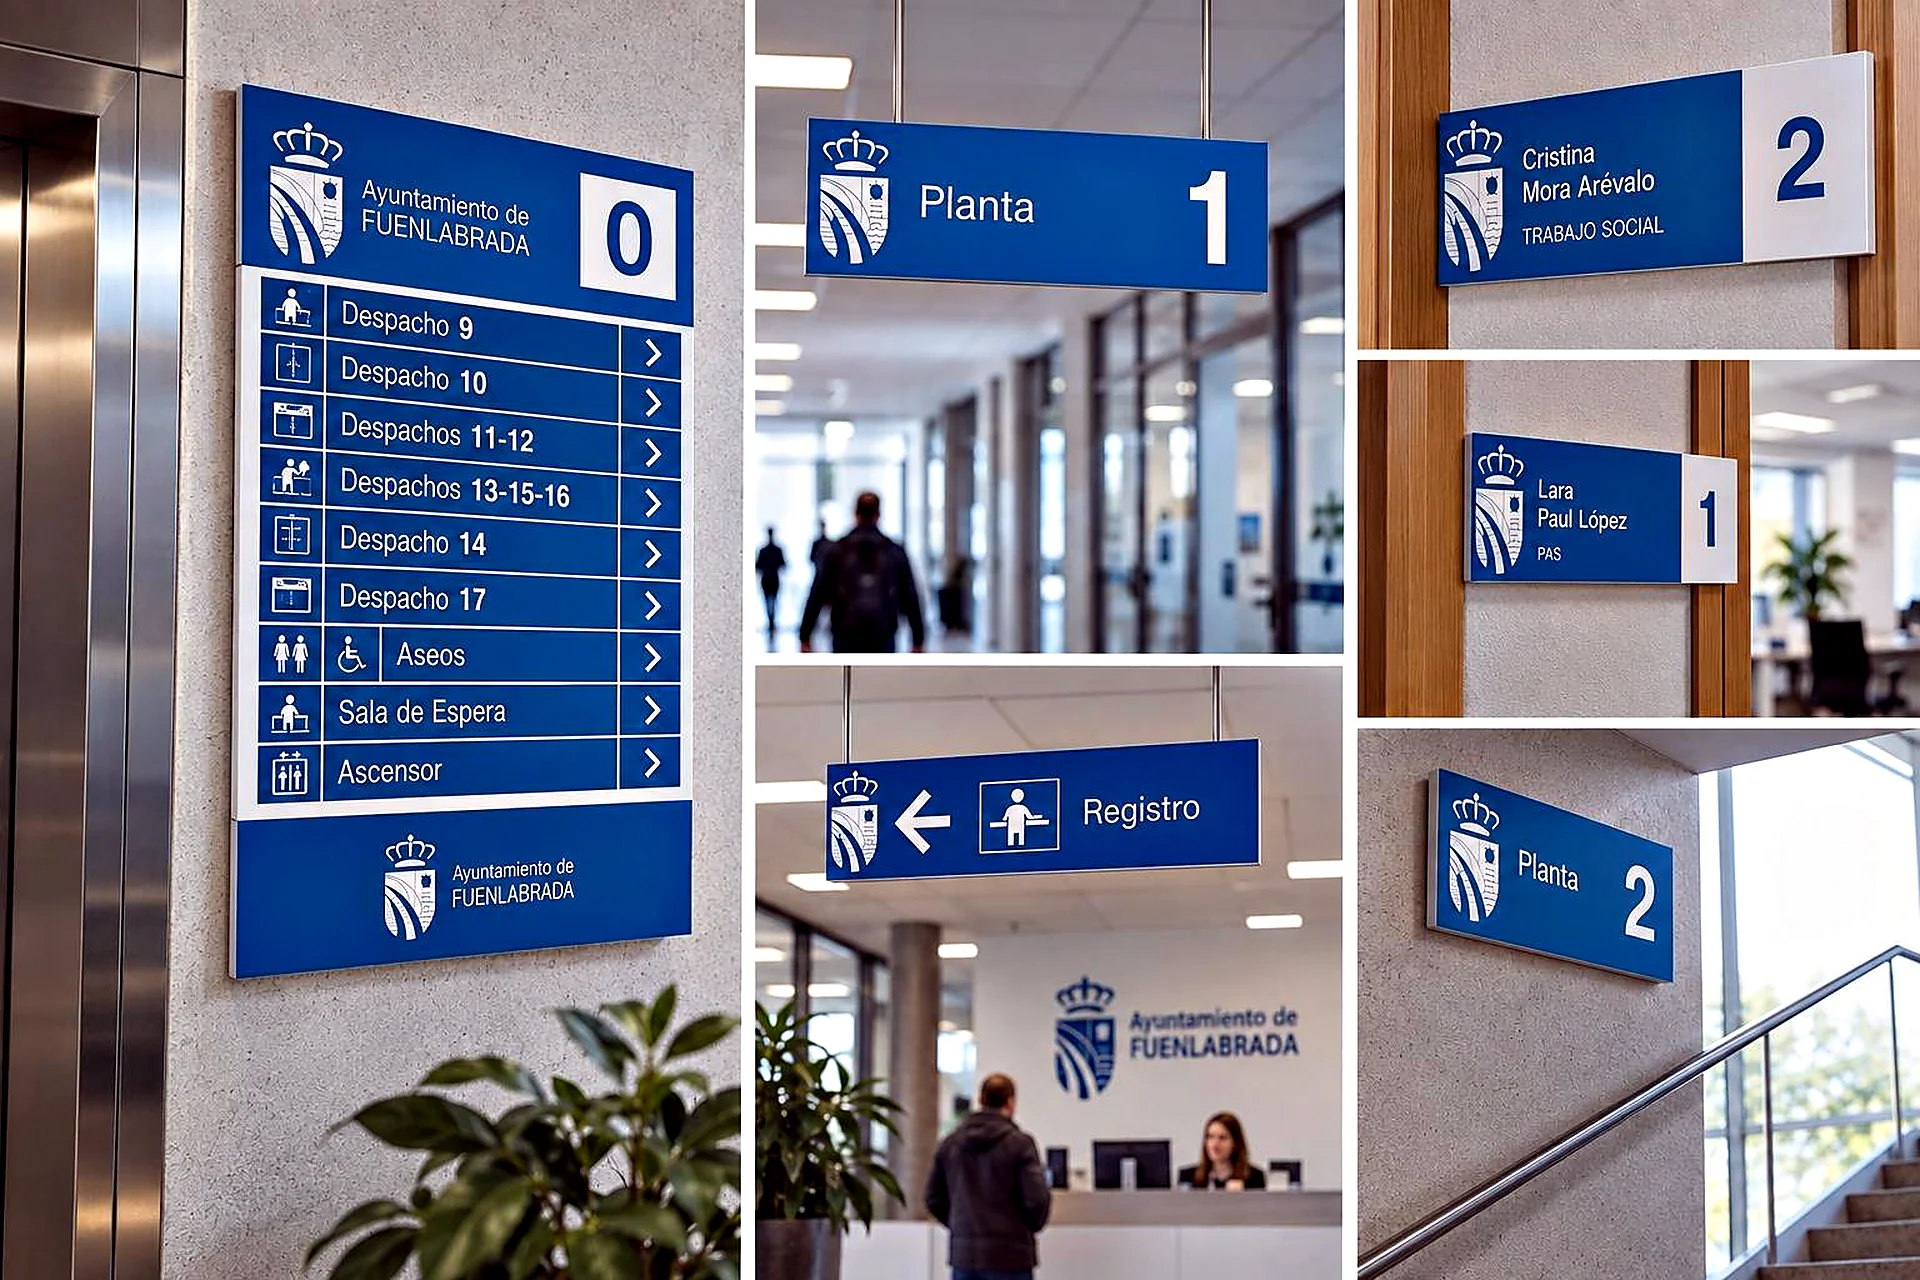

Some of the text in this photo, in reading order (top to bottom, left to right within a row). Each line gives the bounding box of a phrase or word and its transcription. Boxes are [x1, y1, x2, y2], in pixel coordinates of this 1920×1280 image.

[1522, 143, 1595, 170] Cristina
[1776, 115, 1825, 202] 2
[1523, 168, 1655, 204] Mora Arévalo
[362, 180, 530, 227] Ayuntamiento de
[921, 170, 1227, 265] Planta 1
[362, 210, 530, 256] FUENLABRADA
[606, 200, 653, 277] 0
[1522, 215, 1665, 245] TRABAJO SOCIAL
[342, 300, 473, 340] Despacho 9
[342, 355, 487, 395] Despacho 10
[341, 411, 534, 453] Despachos 11-12
[341, 466, 570, 508] Despachos 13-15-16
[1538, 478, 1574, 501] Lara
[1538, 507, 1628, 534] Paul López
[1699, 490, 1716, 548] 1
[340, 524, 487, 558] Despacho 14
[1537, 546, 1562, 561] PAS
[340, 582, 486, 615] Despacho 17
[396, 641, 466, 667] Aseos
[339, 698, 506, 729] Sala de Espera
[337, 759, 443, 785] Ascensor
[1084, 795, 1200, 830] Registro
[452, 857, 575, 885] Ayuntamiento de
[452, 880, 575, 908] FUENLABRADA
[1519, 849, 1655, 942] Planta 2
[1130, 1006, 1298, 1034] Ayuntamiento de
[1130, 1036, 1299, 1060] FUENLABRADA
